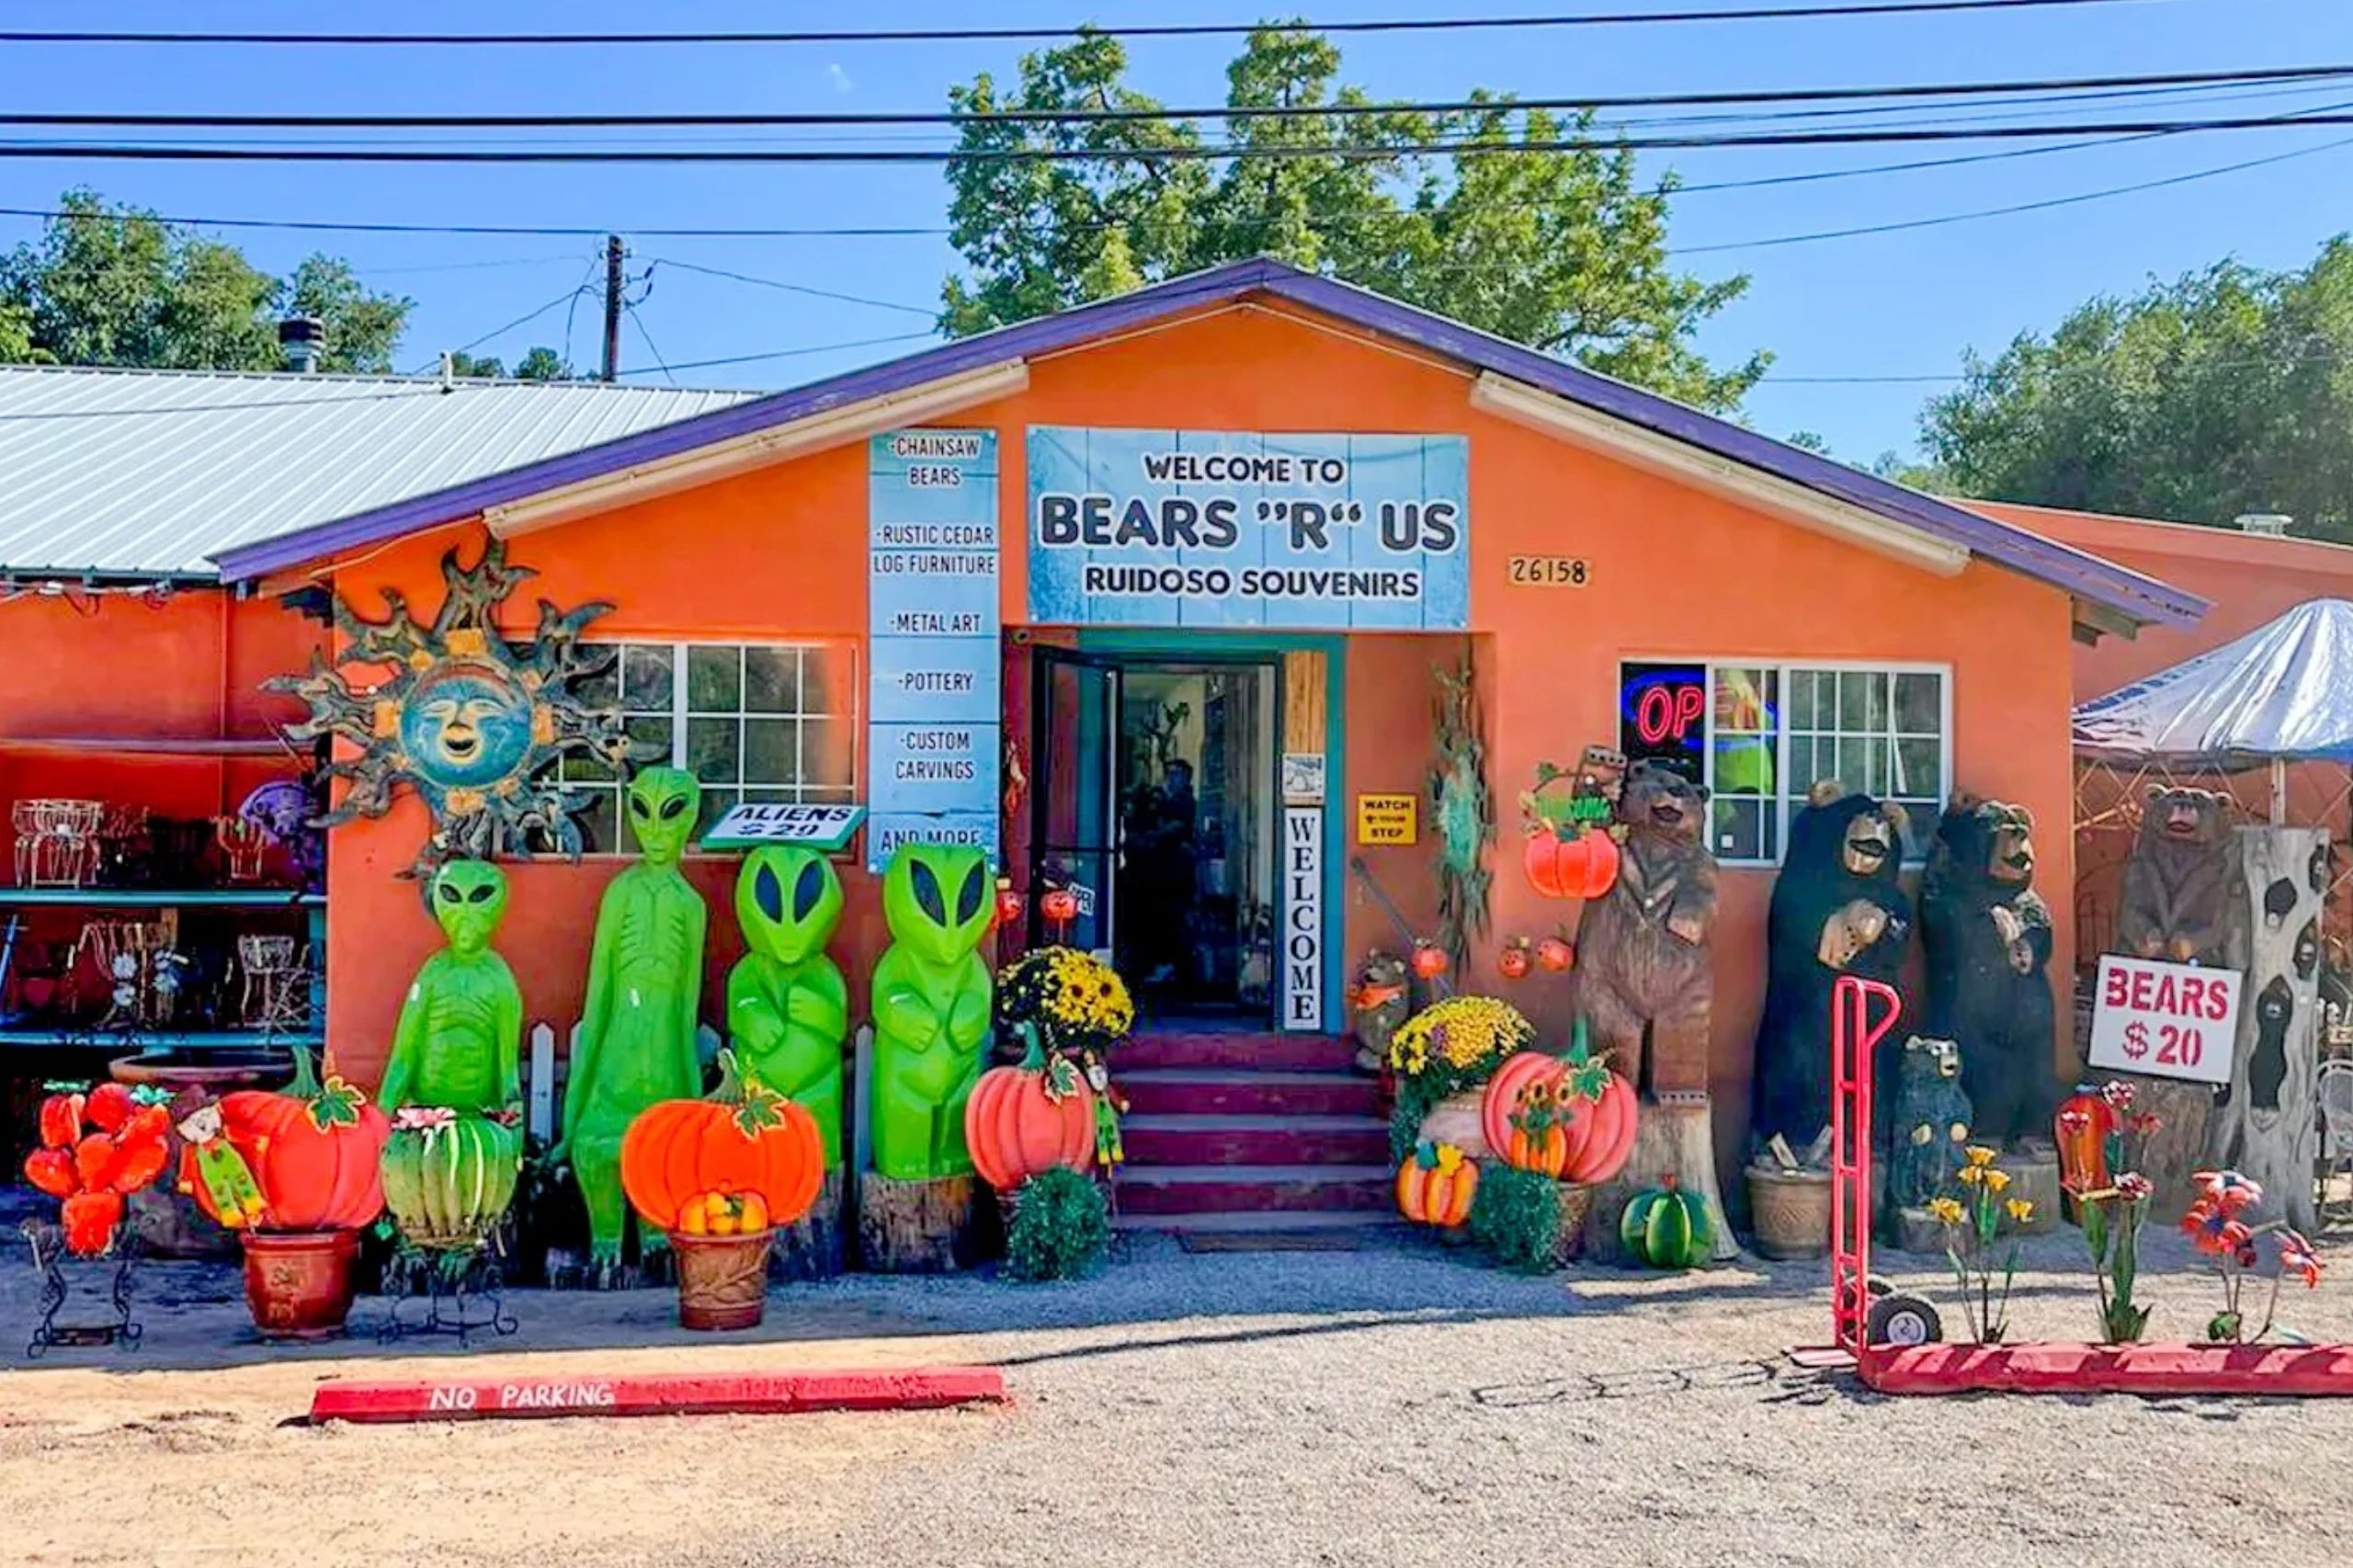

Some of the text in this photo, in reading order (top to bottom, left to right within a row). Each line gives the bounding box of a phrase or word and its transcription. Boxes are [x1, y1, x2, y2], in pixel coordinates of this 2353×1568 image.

[909, 467, 961, 486] BEARS
[1144, 455, 1345, 483] WELCOME TO
[1041, 496, 1238, 548] BEARS
[1381, 503, 1457, 552] US
[942, 526, 995, 545] CEDAR
[874, 554, 995, 574] LOG FURNITURE
[1512, 558, 1586, 585] 26158
[1086, 566, 1419, 597] RUIDOSO SOUVENIRS
[950, 613, 982, 632] ART
[895, 760, 974, 779] CARVINGS
[731, 806, 853, 823] ALIENS
[1364, 799, 1411, 811] WATCH
[881, 830, 980, 851] AND MORE
[1370, 826, 1404, 838] STEP
[1289, 816, 1317, 1020] WELCOME
[2106, 967, 2230, 1022] BEARS
[429, 1382, 617, 1411] NO PARKING
